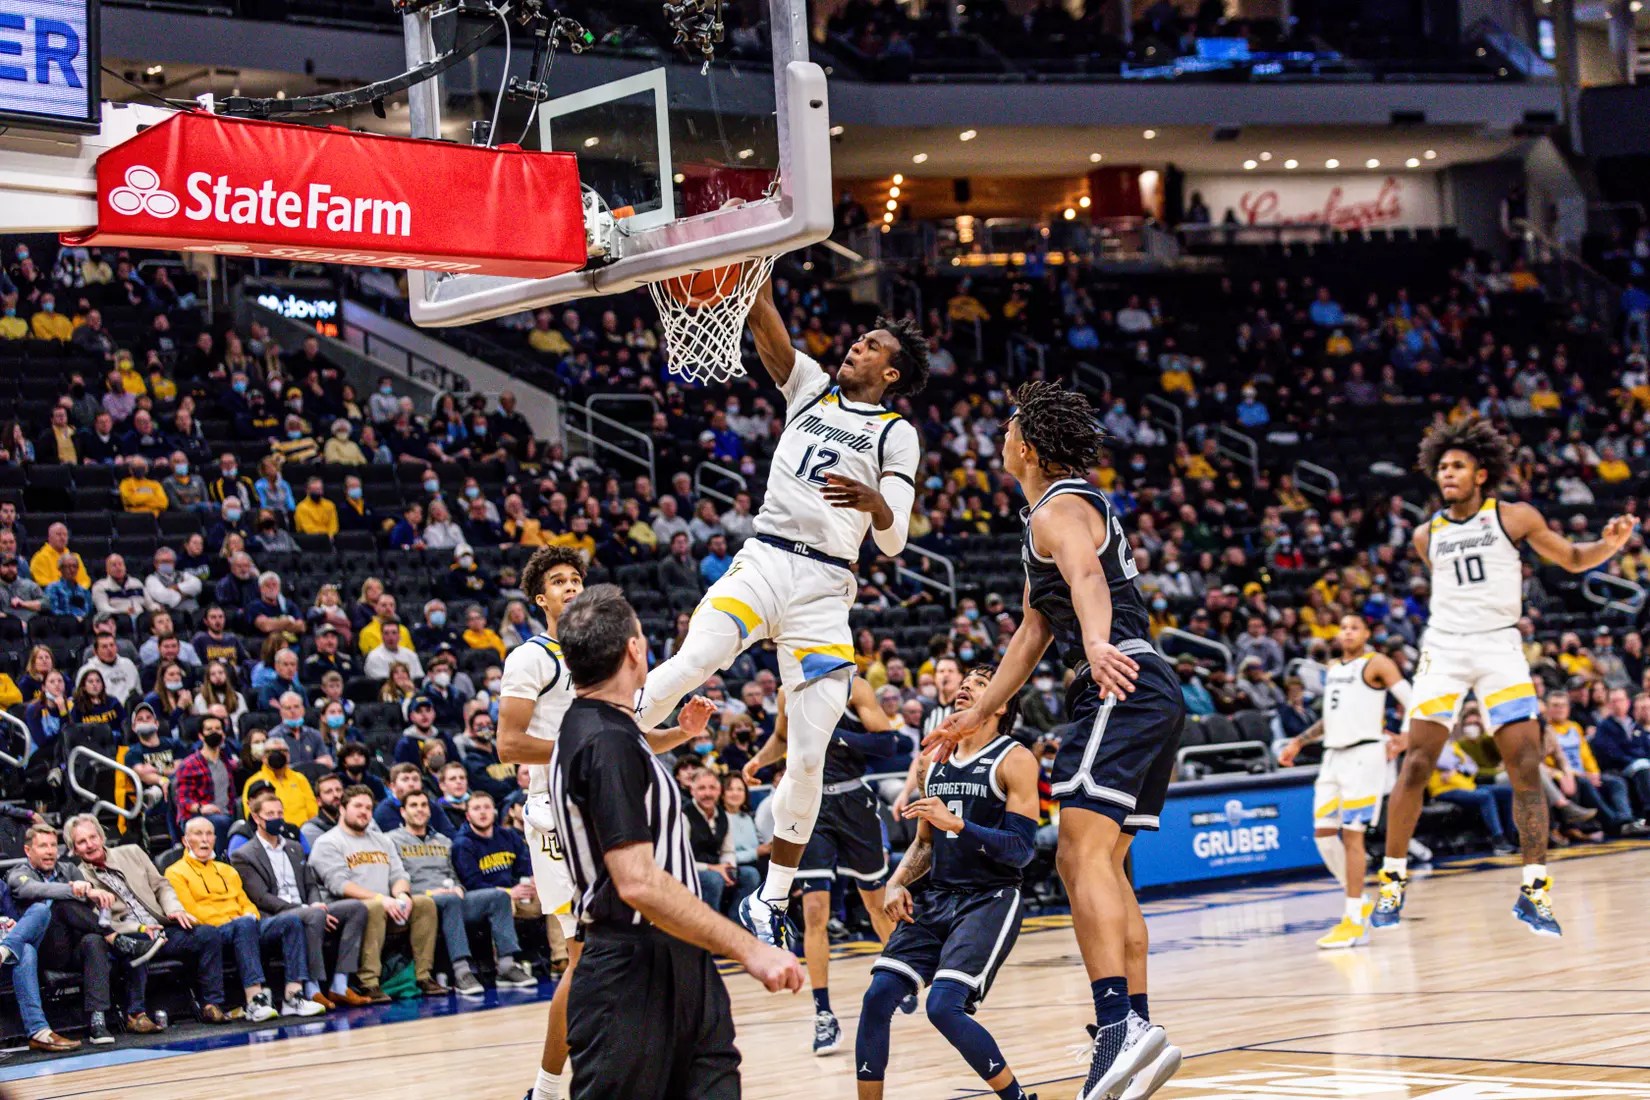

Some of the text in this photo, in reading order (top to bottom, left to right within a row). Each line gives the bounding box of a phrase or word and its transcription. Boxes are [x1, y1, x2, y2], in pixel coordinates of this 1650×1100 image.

[796, 414, 874, 454] Marquette
[795, 443, 841, 487] 12
[1454, 555, 1486, 586] 10
[928, 782, 988, 798] GEORGETOWN
[1193, 824, 1280, 859] GRUBER
